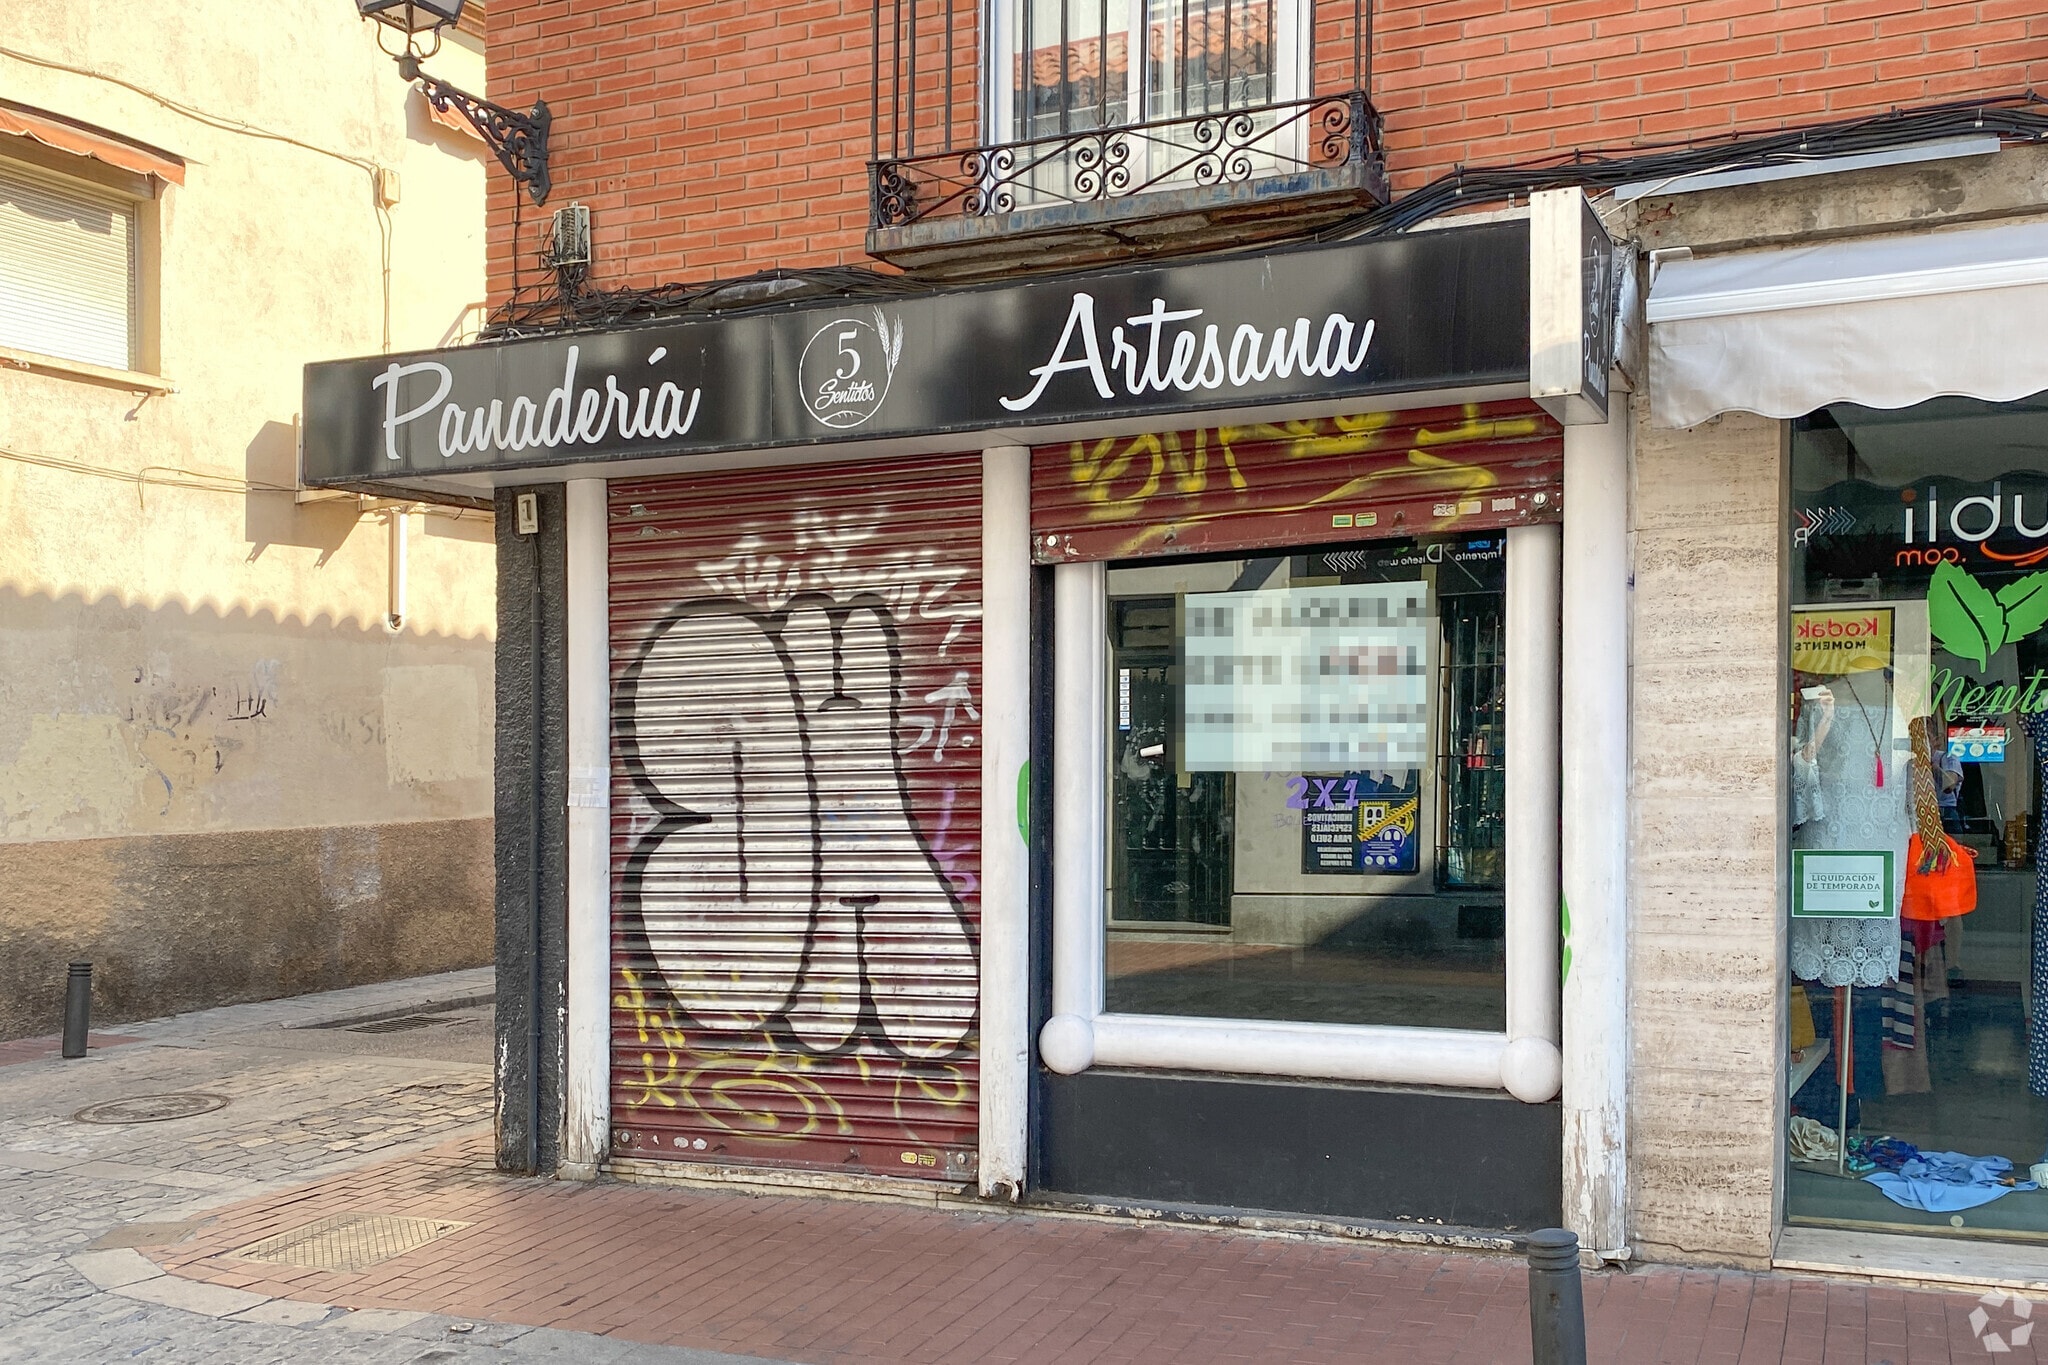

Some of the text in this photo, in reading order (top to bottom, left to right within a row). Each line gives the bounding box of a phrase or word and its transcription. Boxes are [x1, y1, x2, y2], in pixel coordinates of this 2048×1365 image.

[836, 328, 861, 379] 5
[999, 292, 1375, 412] Artesana
[371, 345, 702, 460] Panadería
[814, 378, 875, 410] Sentidos
[1811, 874, 1876, 882] LIQUIDACIÓN
